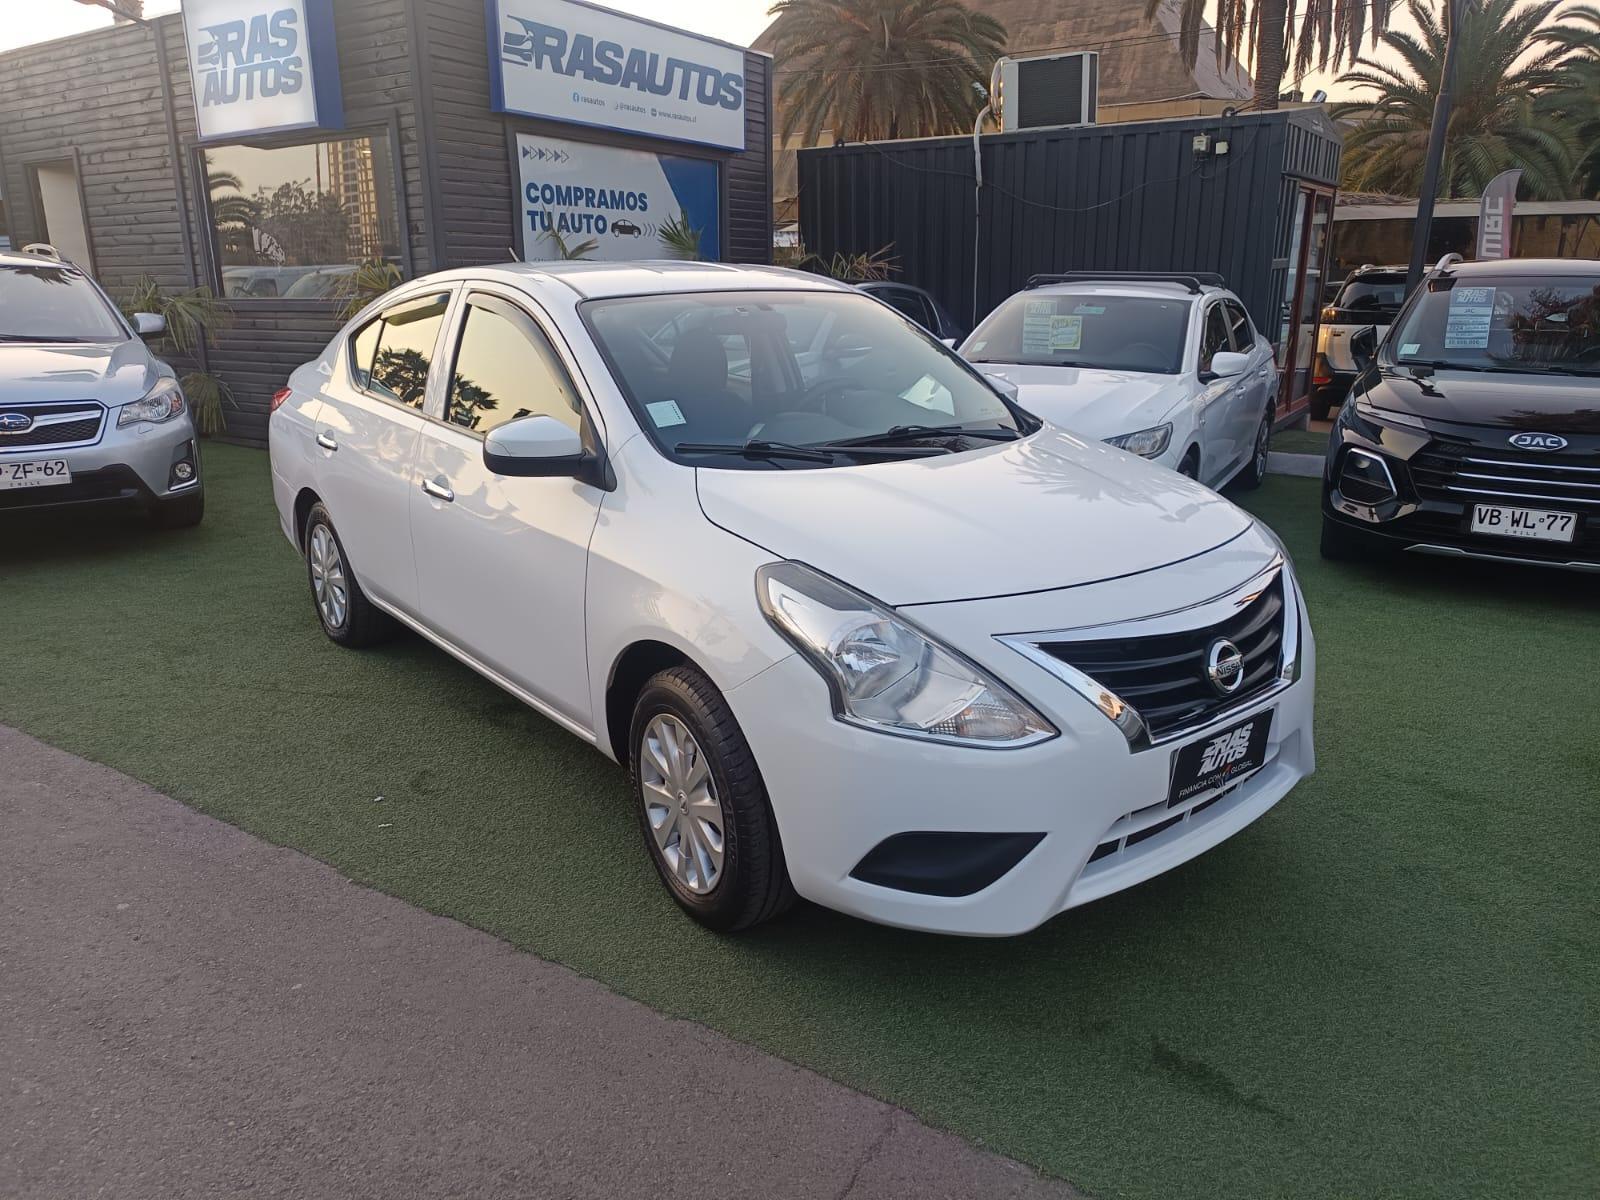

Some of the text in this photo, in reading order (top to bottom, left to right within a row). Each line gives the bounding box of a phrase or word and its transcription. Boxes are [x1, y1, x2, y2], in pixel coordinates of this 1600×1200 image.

[198, 8, 298, 68] RAS
[502, 15, 743, 111] RASAUTOS
[202, 56, 303, 107] AUTOS
[580, 95, 605, 107] rasautos
[525, 182, 648, 212] COMPRAMOS
[526, 210, 608, 235] TU AUTO
[1517, 435, 1560, 447] JAC
[1202, 722, 1254, 757] RAS
[1197, 741, 1250, 777] AUTOS
